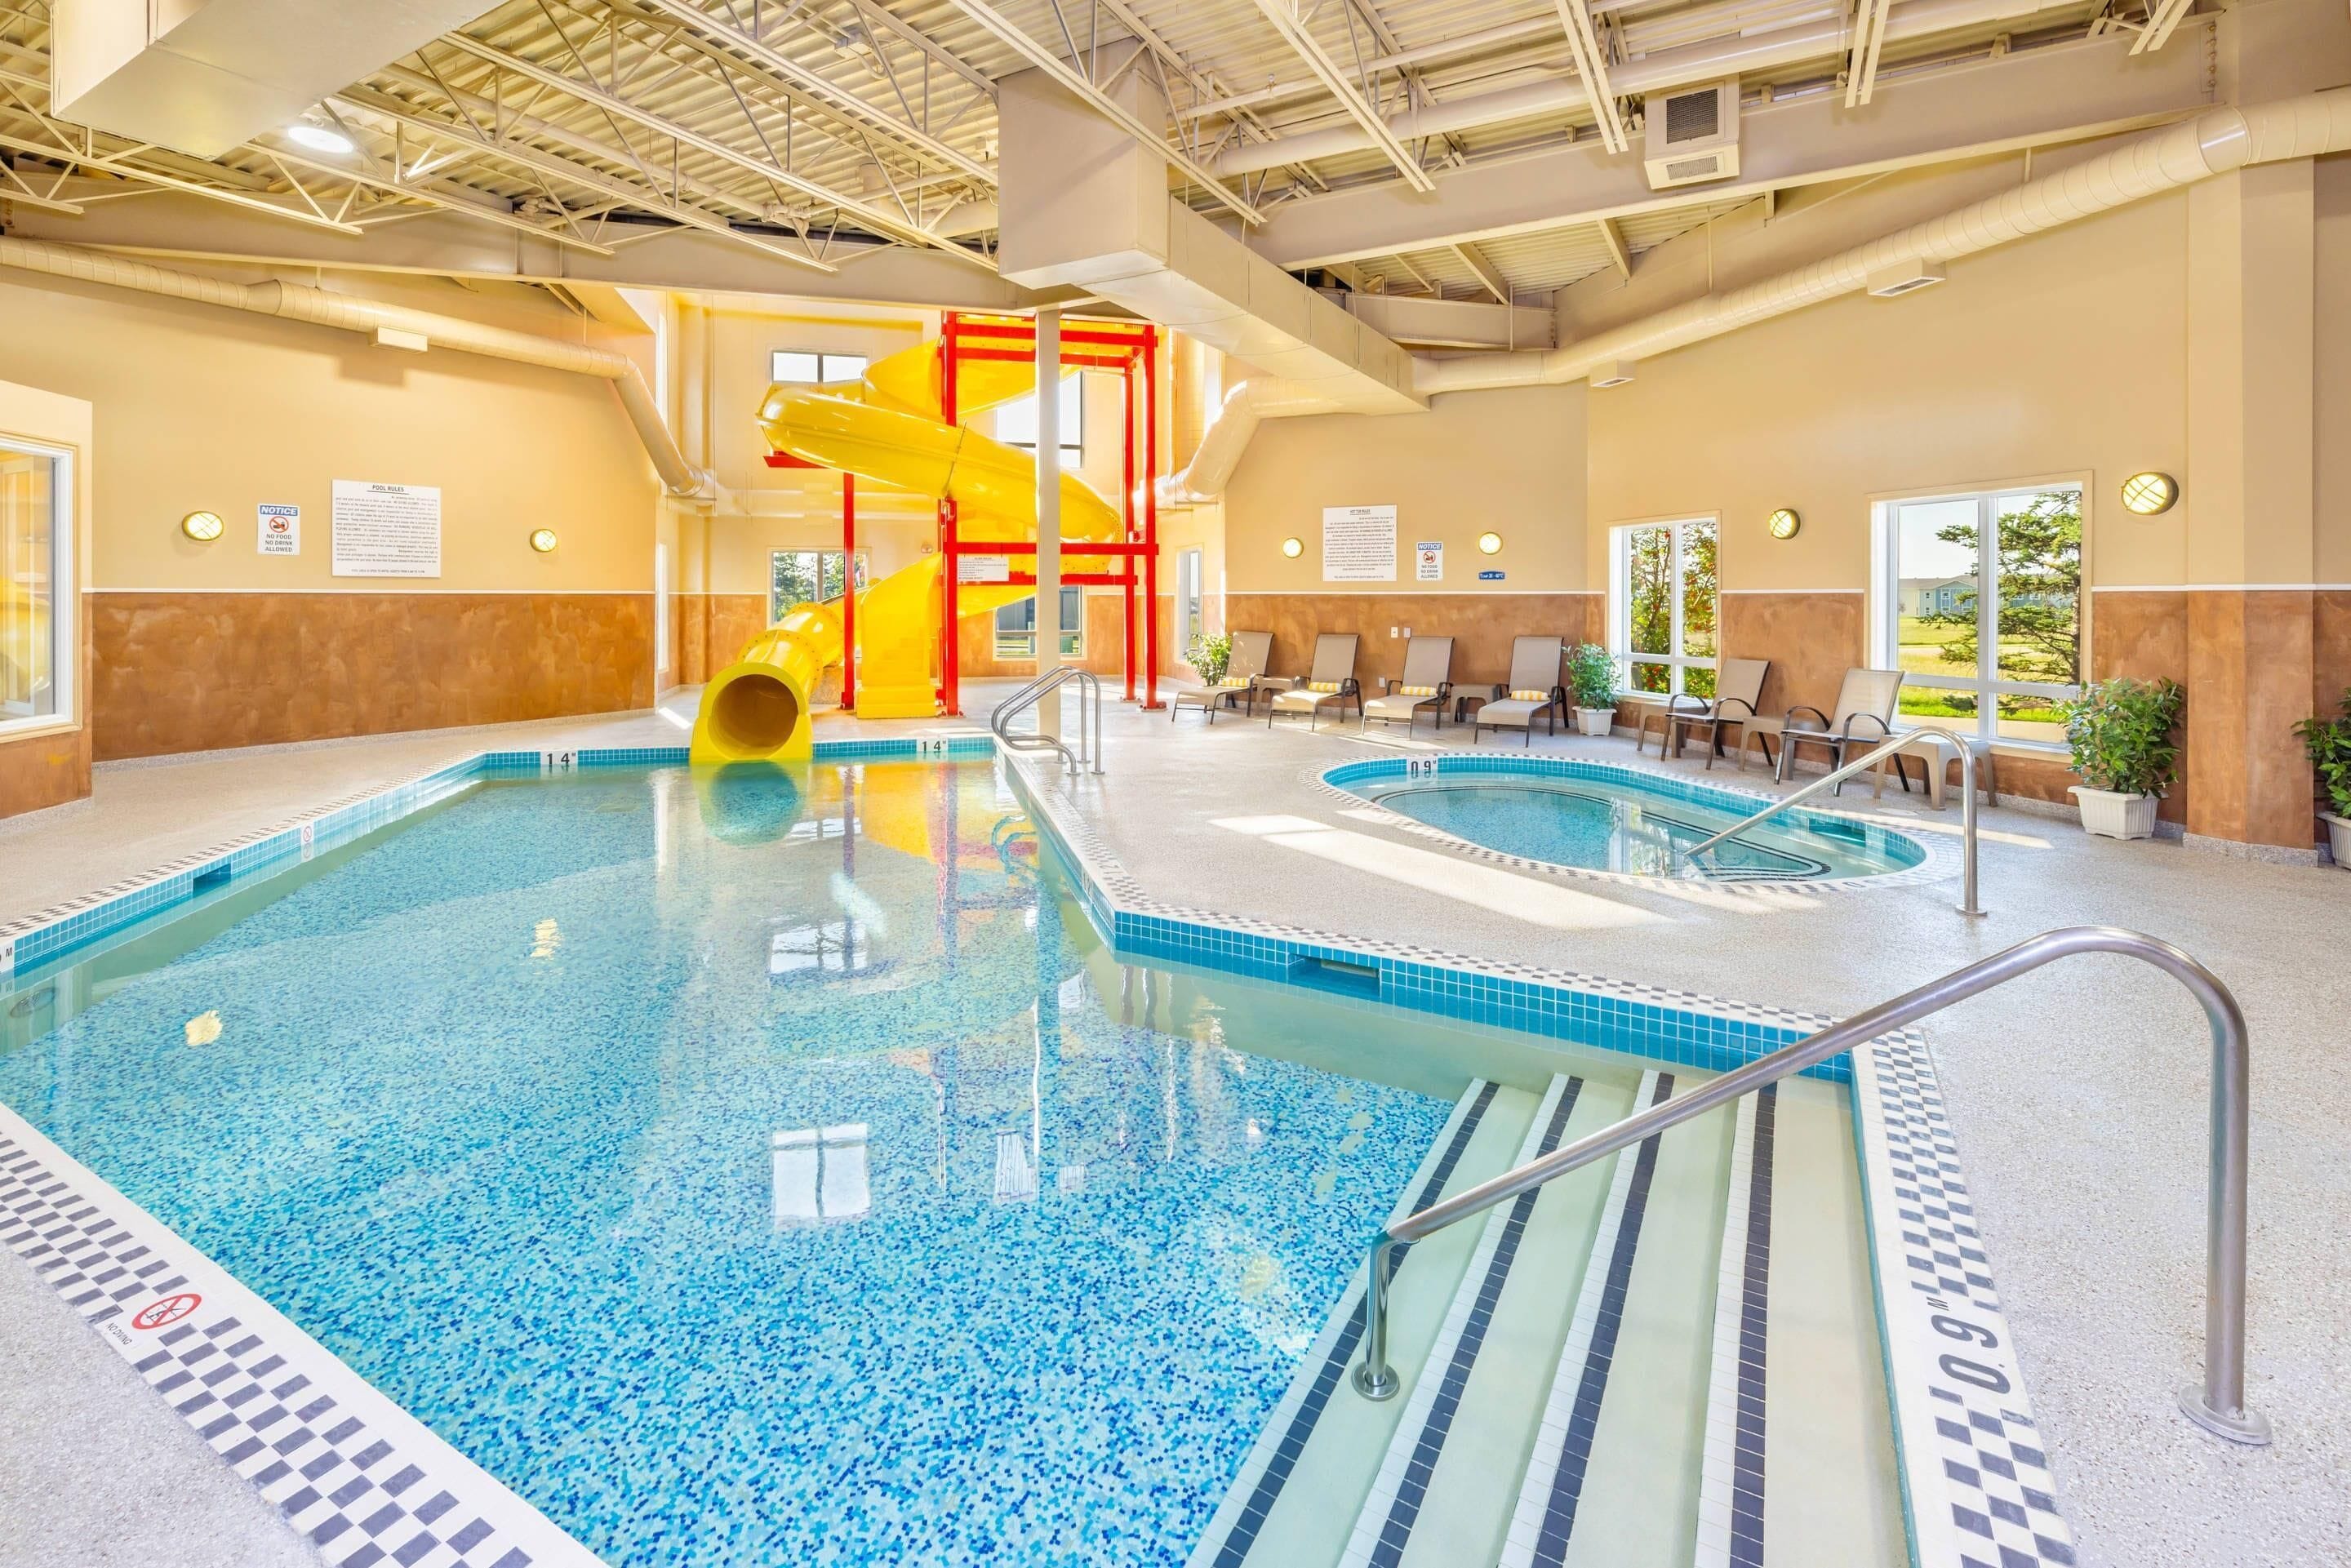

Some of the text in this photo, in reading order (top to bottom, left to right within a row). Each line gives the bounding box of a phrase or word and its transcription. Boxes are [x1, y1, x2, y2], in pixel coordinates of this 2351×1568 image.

[260, 506, 297, 515] NOTICE
[105, 1322, 132, 1345] NO DIVING
